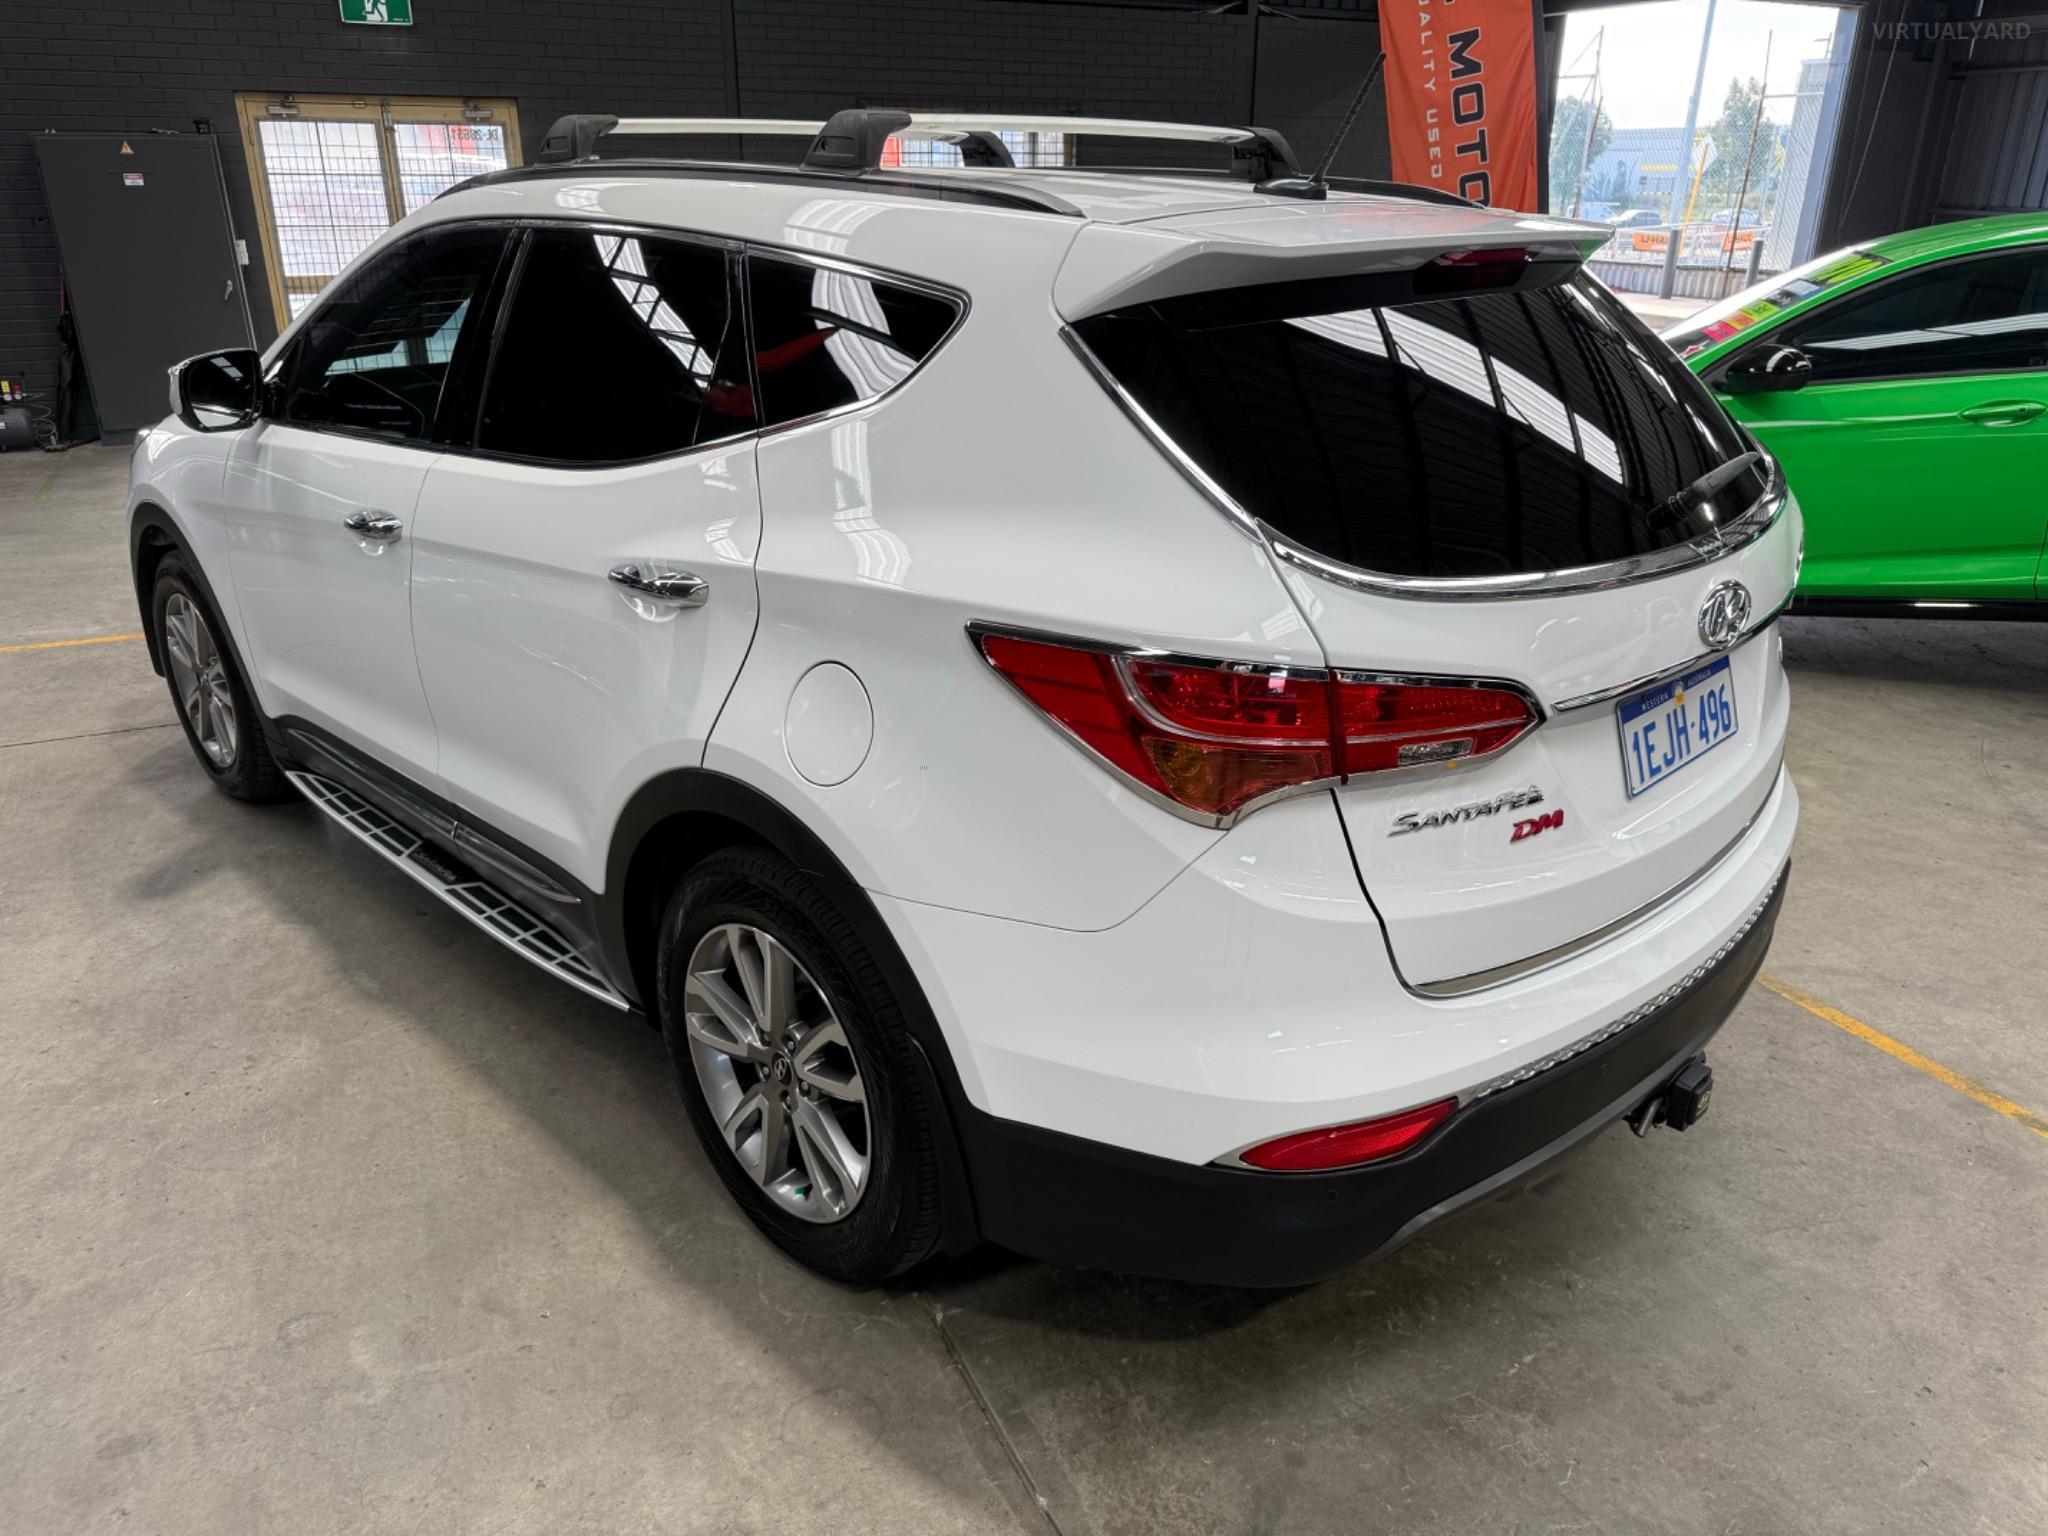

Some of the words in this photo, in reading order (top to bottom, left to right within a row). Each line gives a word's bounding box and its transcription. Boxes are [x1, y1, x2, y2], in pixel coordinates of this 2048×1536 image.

[1426, 108, 1442, 178] USED
[1447, 26, 1491, 208] MOTO
[1510, 808, 1564, 843] DM
